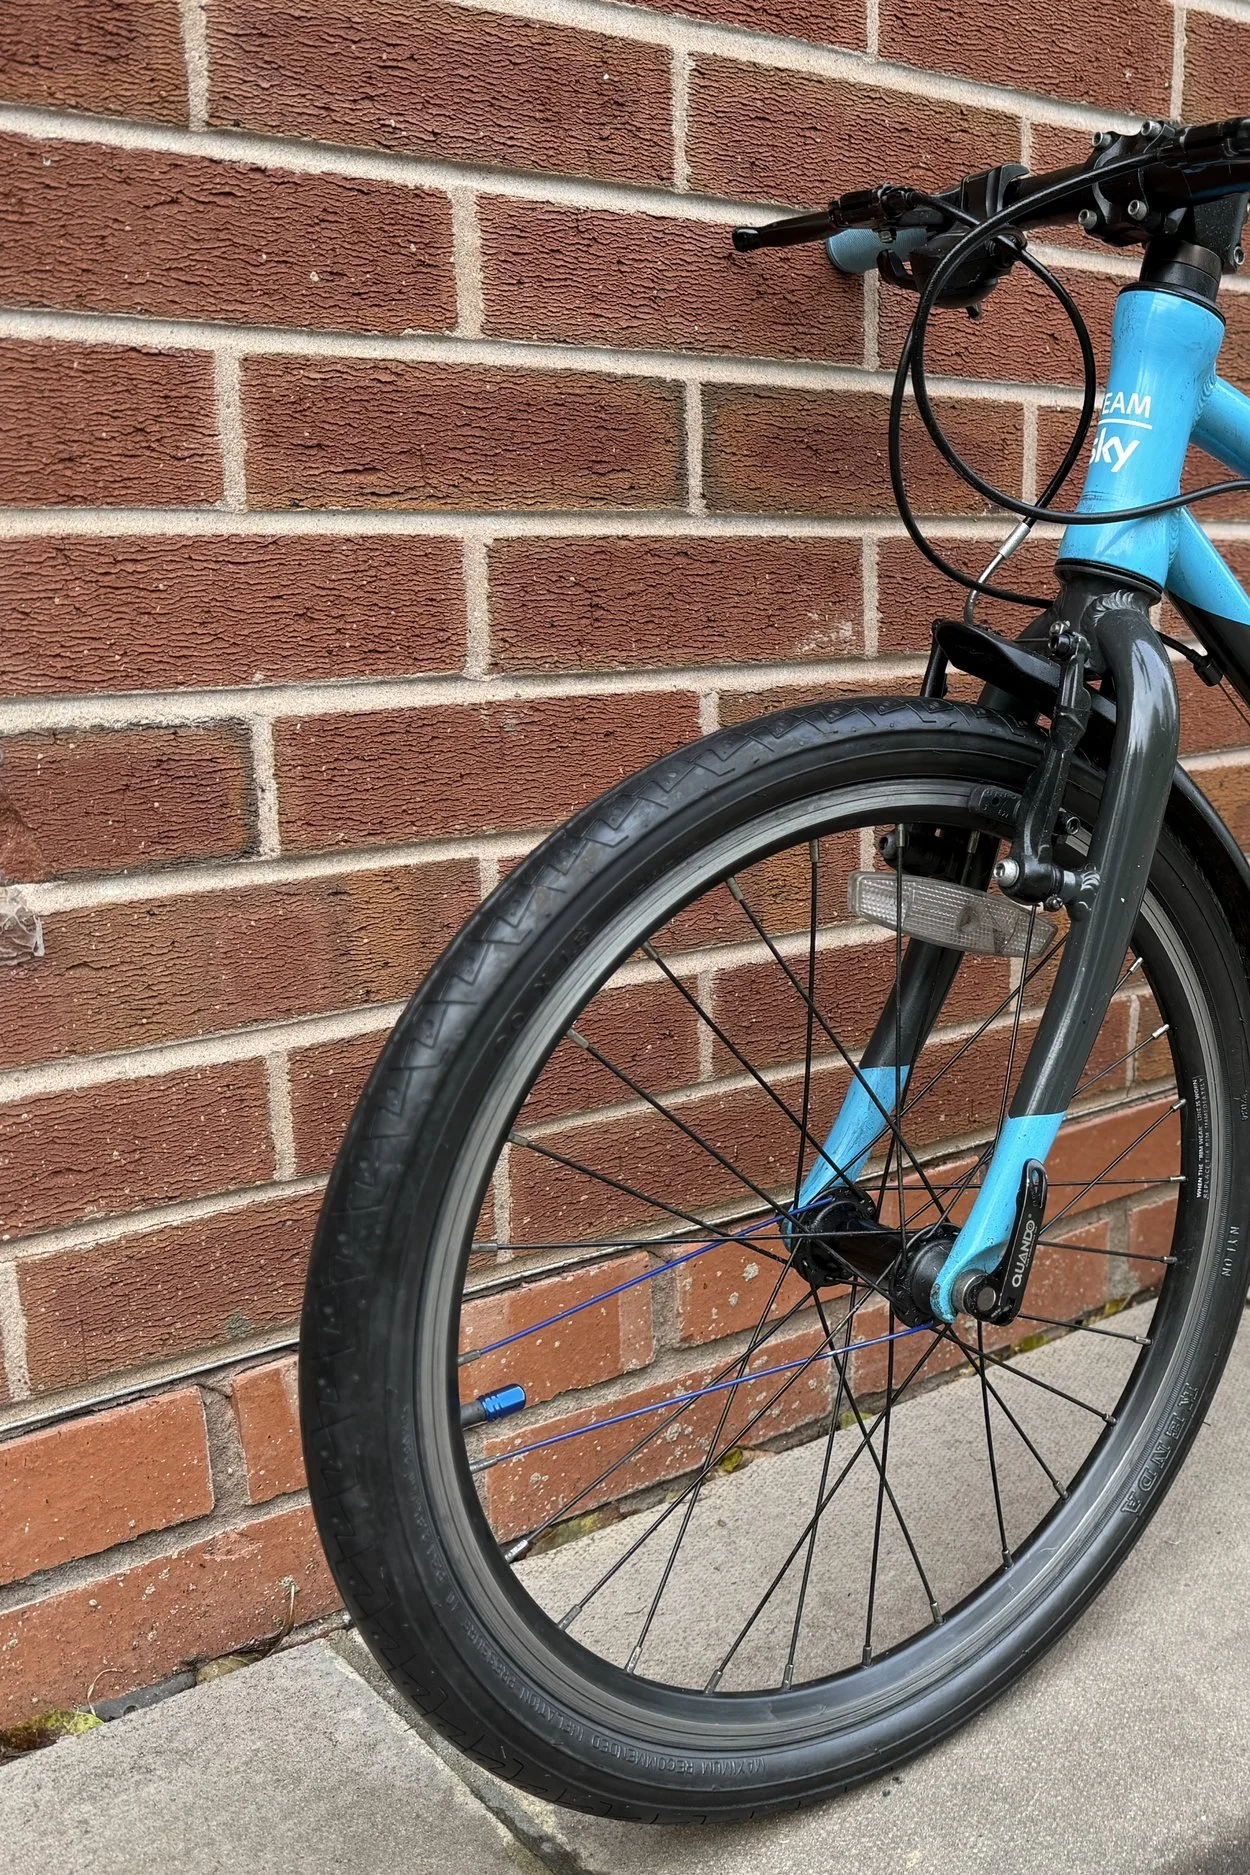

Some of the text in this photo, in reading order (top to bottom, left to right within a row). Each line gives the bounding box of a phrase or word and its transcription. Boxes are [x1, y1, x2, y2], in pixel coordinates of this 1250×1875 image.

[1102, 391, 1152, 418] EAM
[1012, 1219, 1035, 1288] QUANDO
[1122, 1383, 1199, 1513] KENDA
